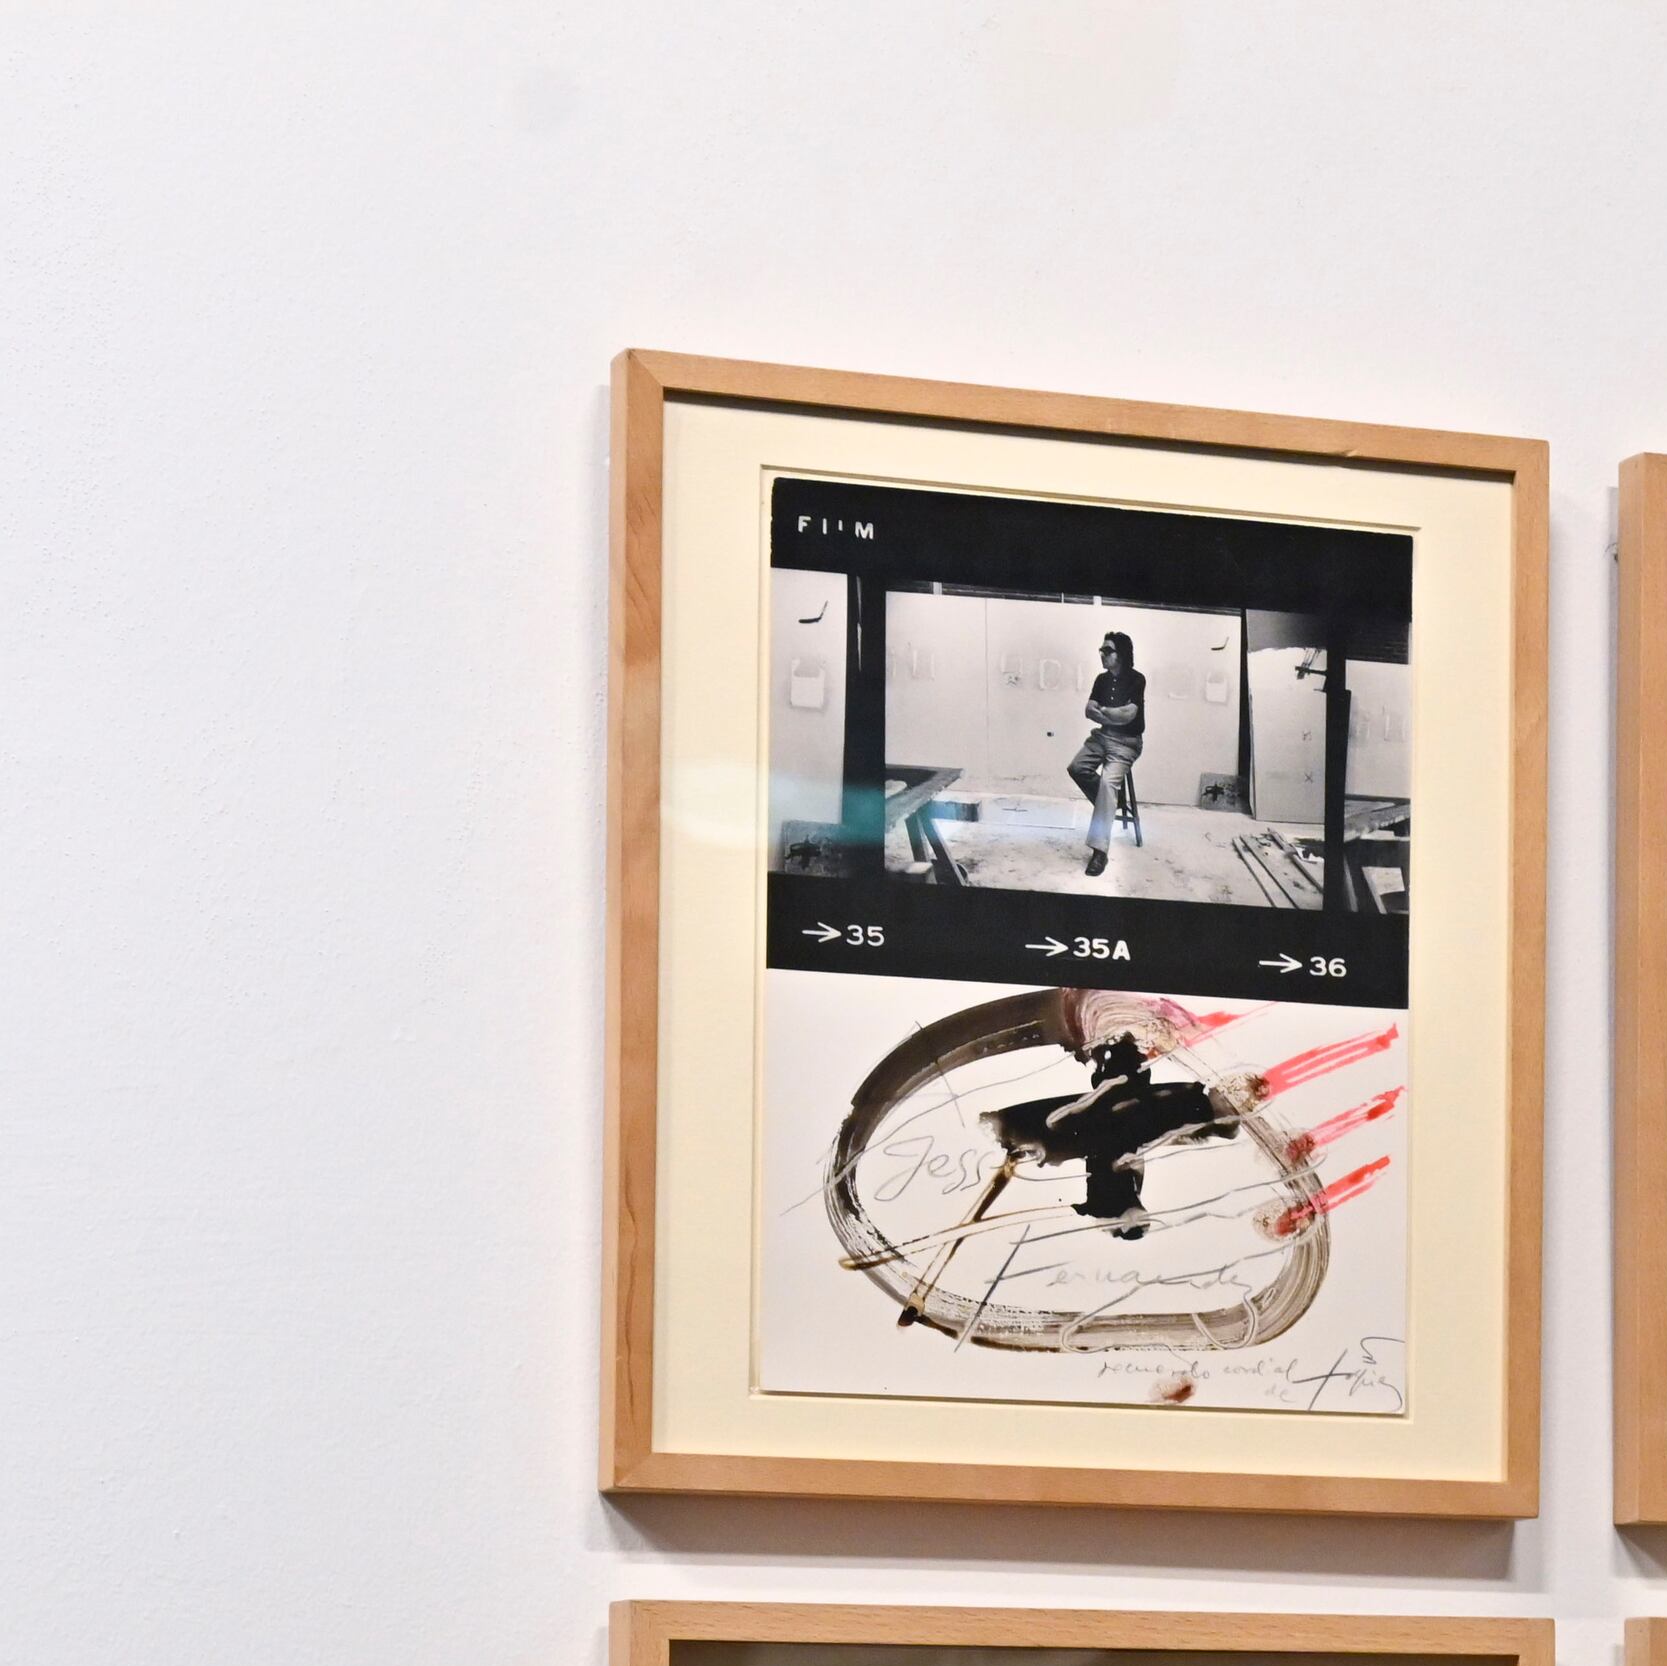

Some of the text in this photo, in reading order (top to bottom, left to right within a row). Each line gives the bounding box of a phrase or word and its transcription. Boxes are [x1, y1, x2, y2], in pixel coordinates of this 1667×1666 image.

[845, 924, 886, 949] 35
[1072, 937, 1132, 962] 35A
[1308, 957, 1348, 980] 36
